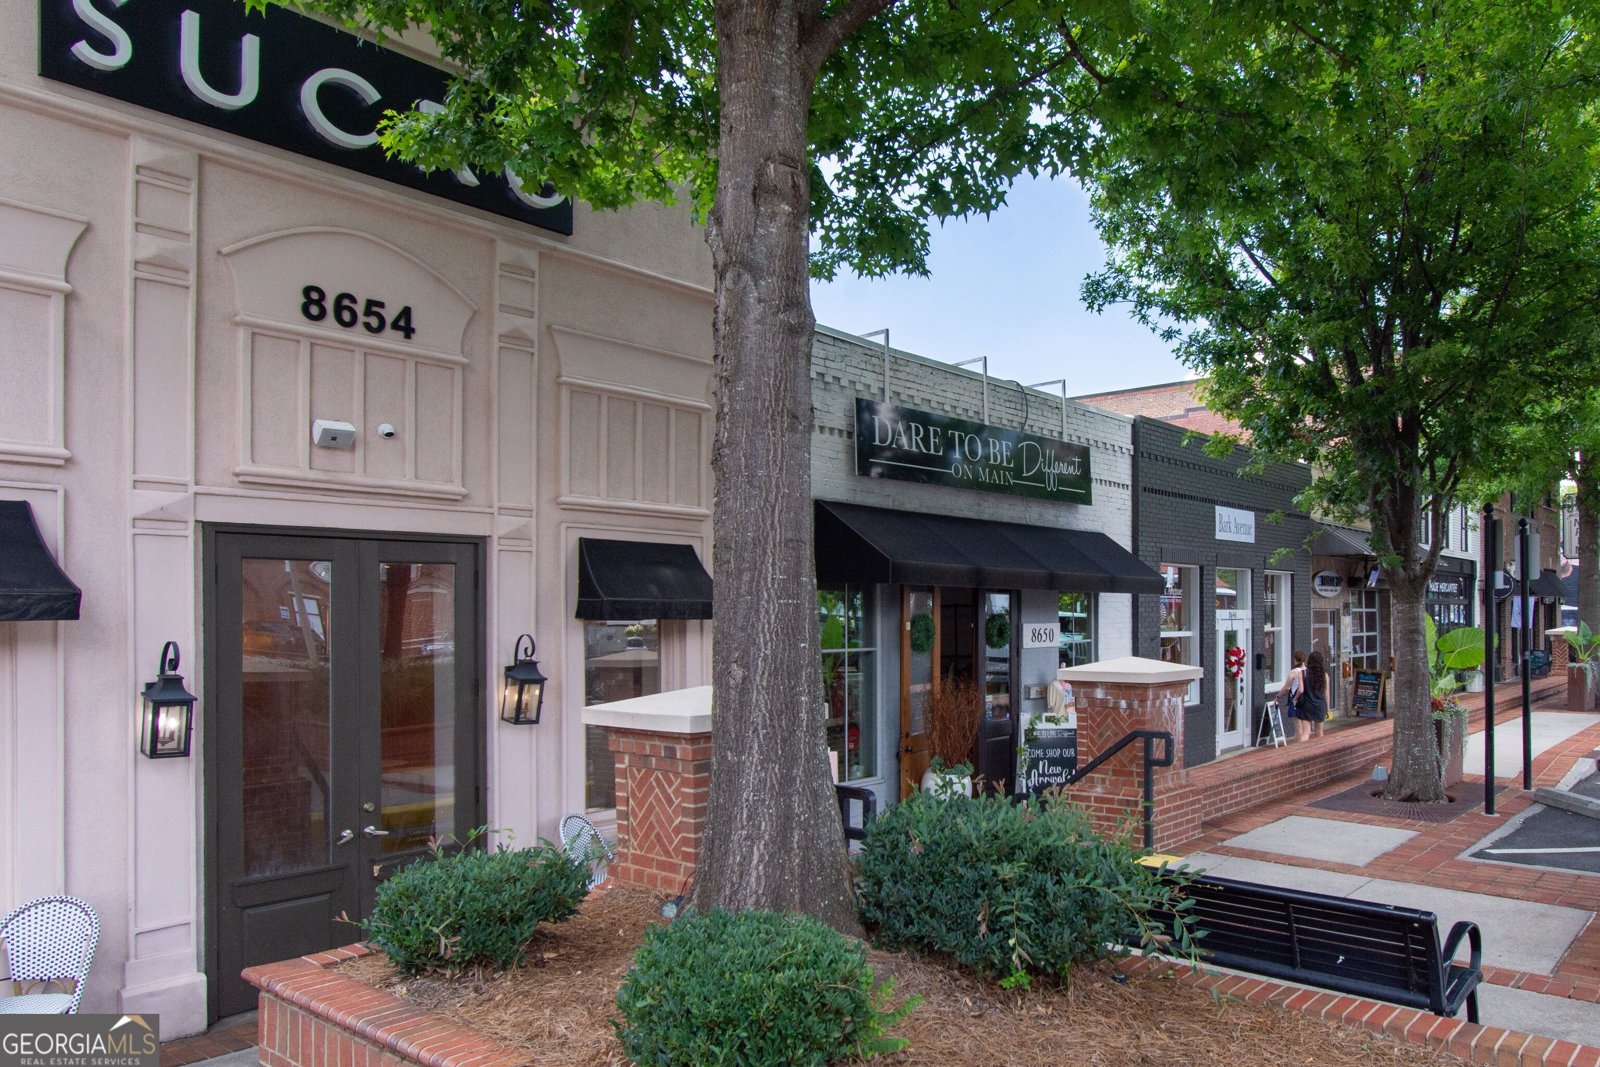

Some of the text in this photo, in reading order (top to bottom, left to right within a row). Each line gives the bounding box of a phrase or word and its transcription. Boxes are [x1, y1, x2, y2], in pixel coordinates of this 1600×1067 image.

[301, 284, 416, 340] 8654
[872, 415, 1082, 492] DARE TO BE Different
[952, 462, 1014, 486] ON MAIN
[1031, 627, 1054, 643] 8650
[1027, 747, 1076, 759] COME SHOP OUR
[1038, 759, 1062, 775] New
